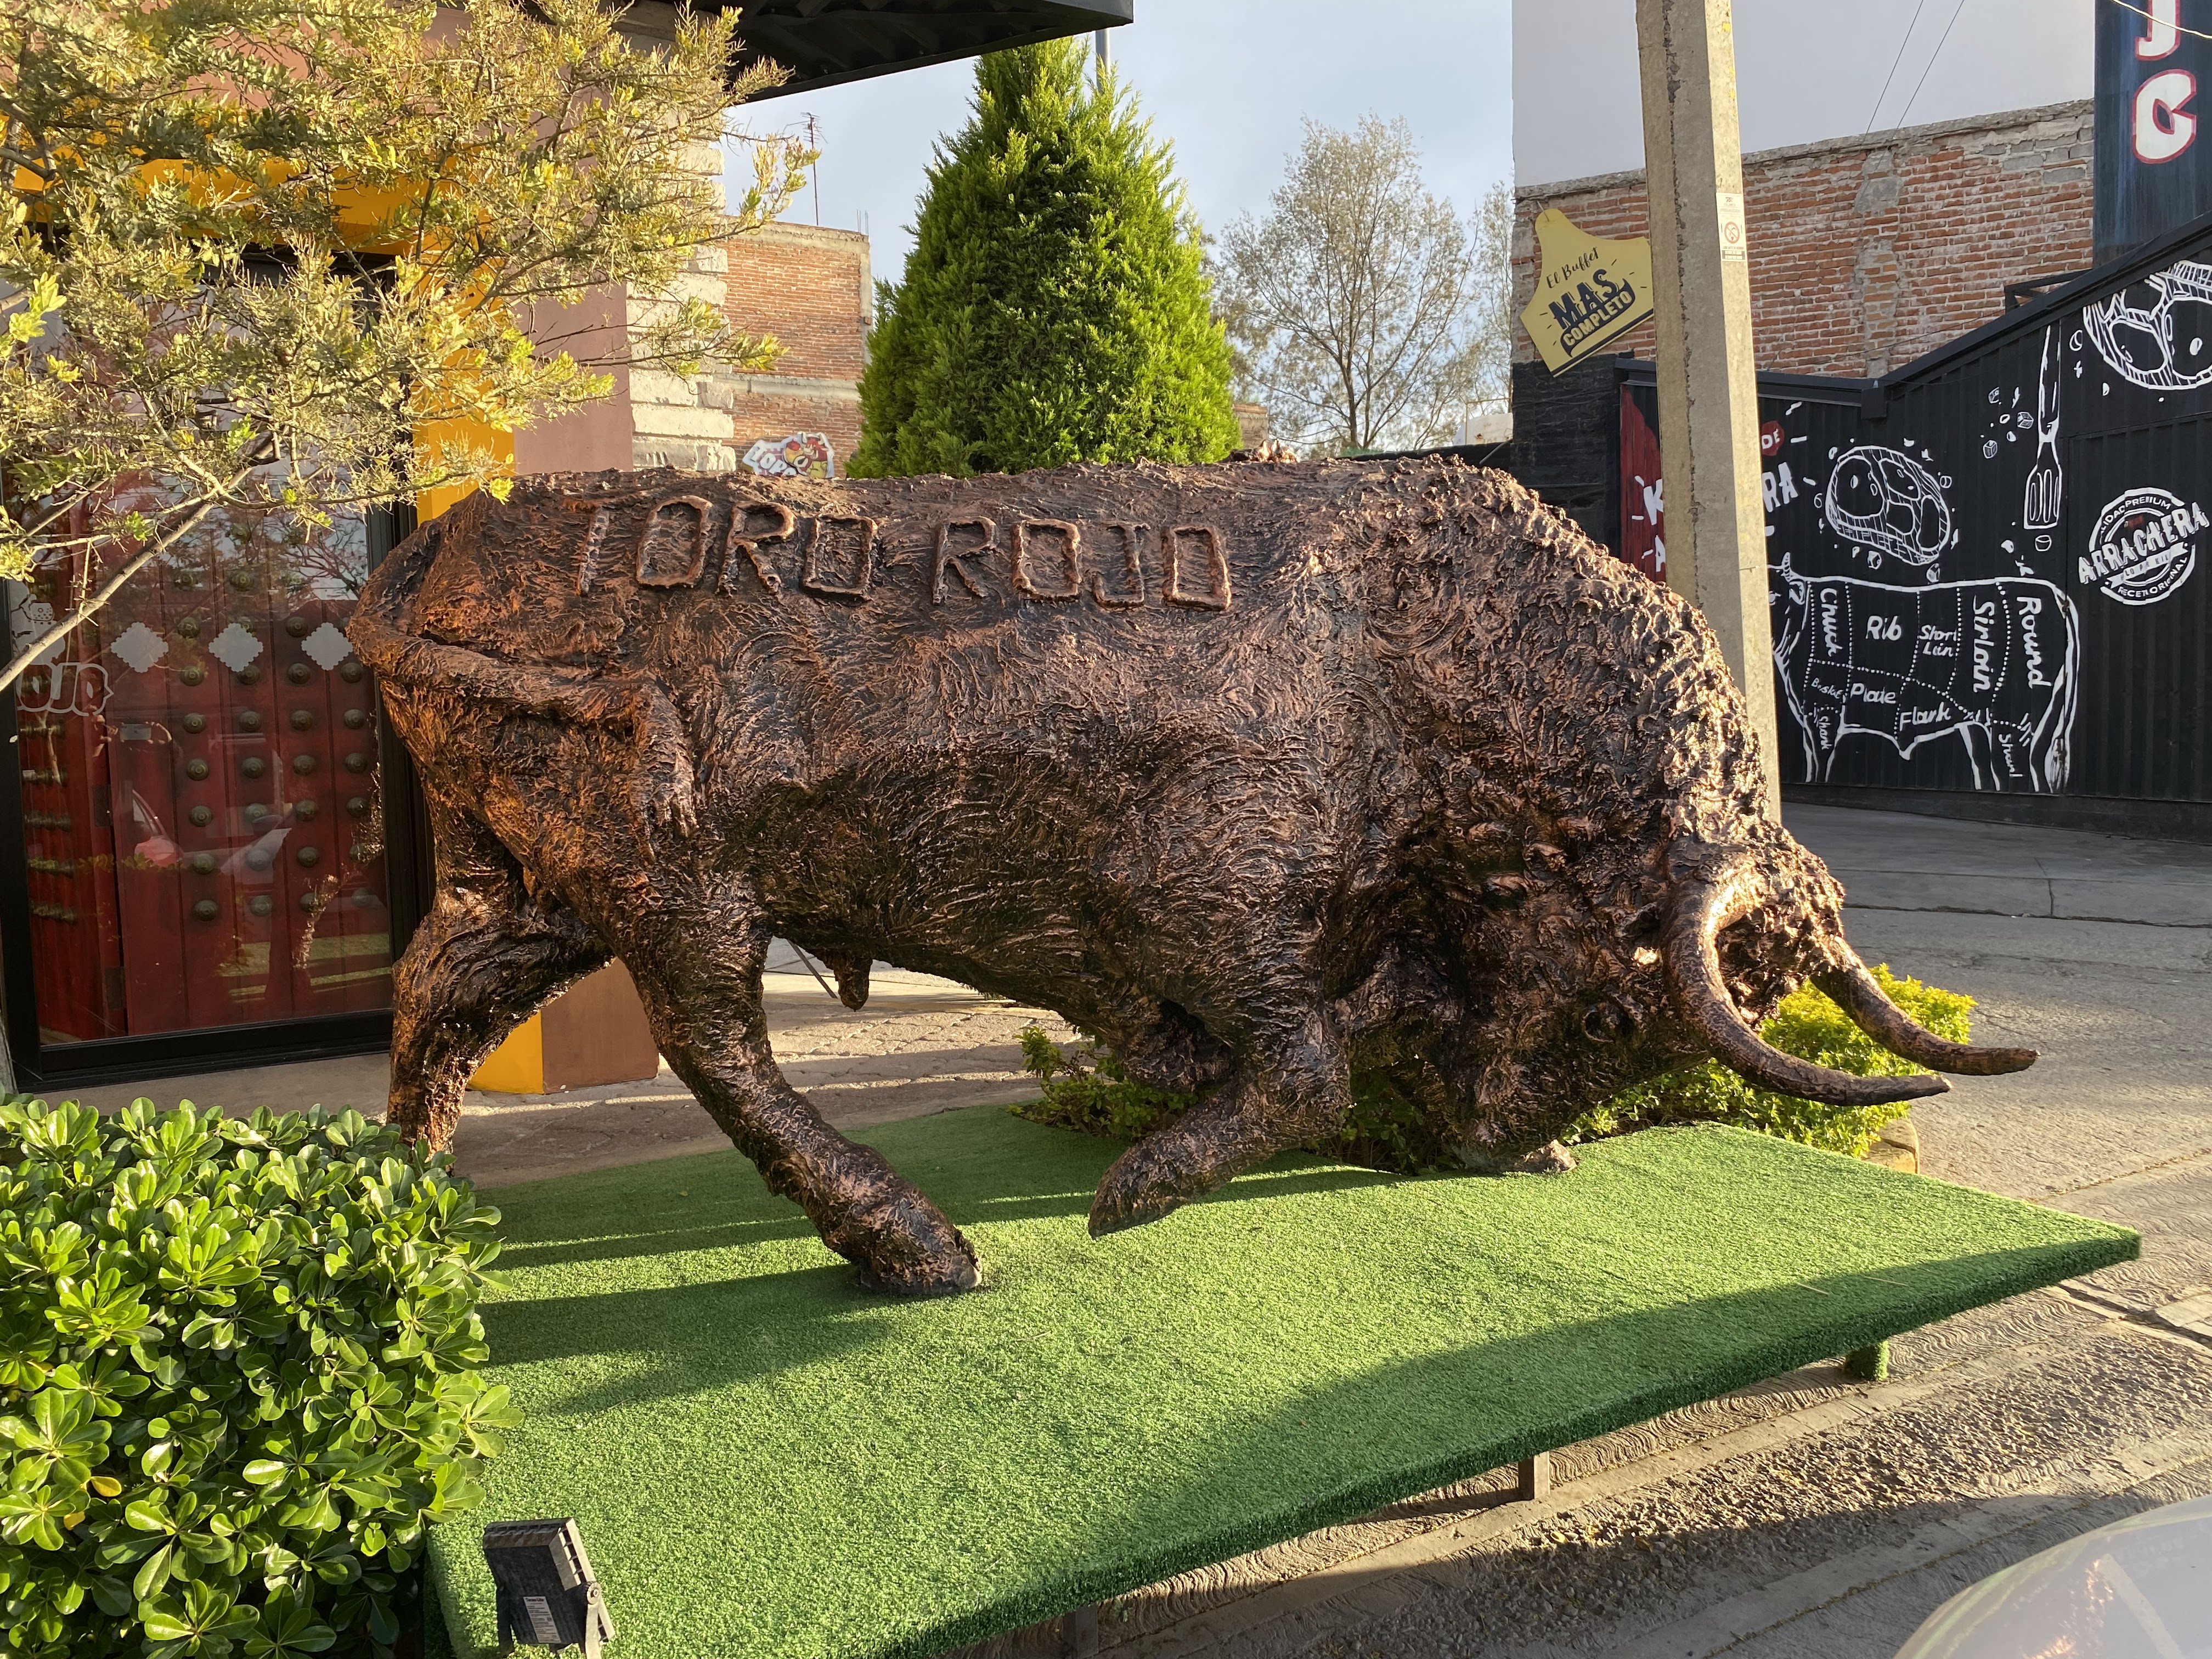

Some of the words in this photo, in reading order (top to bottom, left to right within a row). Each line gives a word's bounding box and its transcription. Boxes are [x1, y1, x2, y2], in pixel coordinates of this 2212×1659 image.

[1546, 272, 1561, 289] El
[1561, 246, 1599, 281] Buffet
[1548, 268, 1620, 330] MAS
[1562, 291, 1632, 346] COMPLETO
[1761, 428, 1781, 449] DE
[1761, 461, 1798, 513] RA
[562, 494, 879, 603] TORO
[933, 515, 1232, 610] ROJO
[2078, 501, 2210, 584] ARRACHERA
[1865, 615, 1903, 641] Rib
[1973, 594, 1995, 693] Sirloin
[2016, 596, 2052, 689] Round
[1850, 682, 1897, 704] Plate
